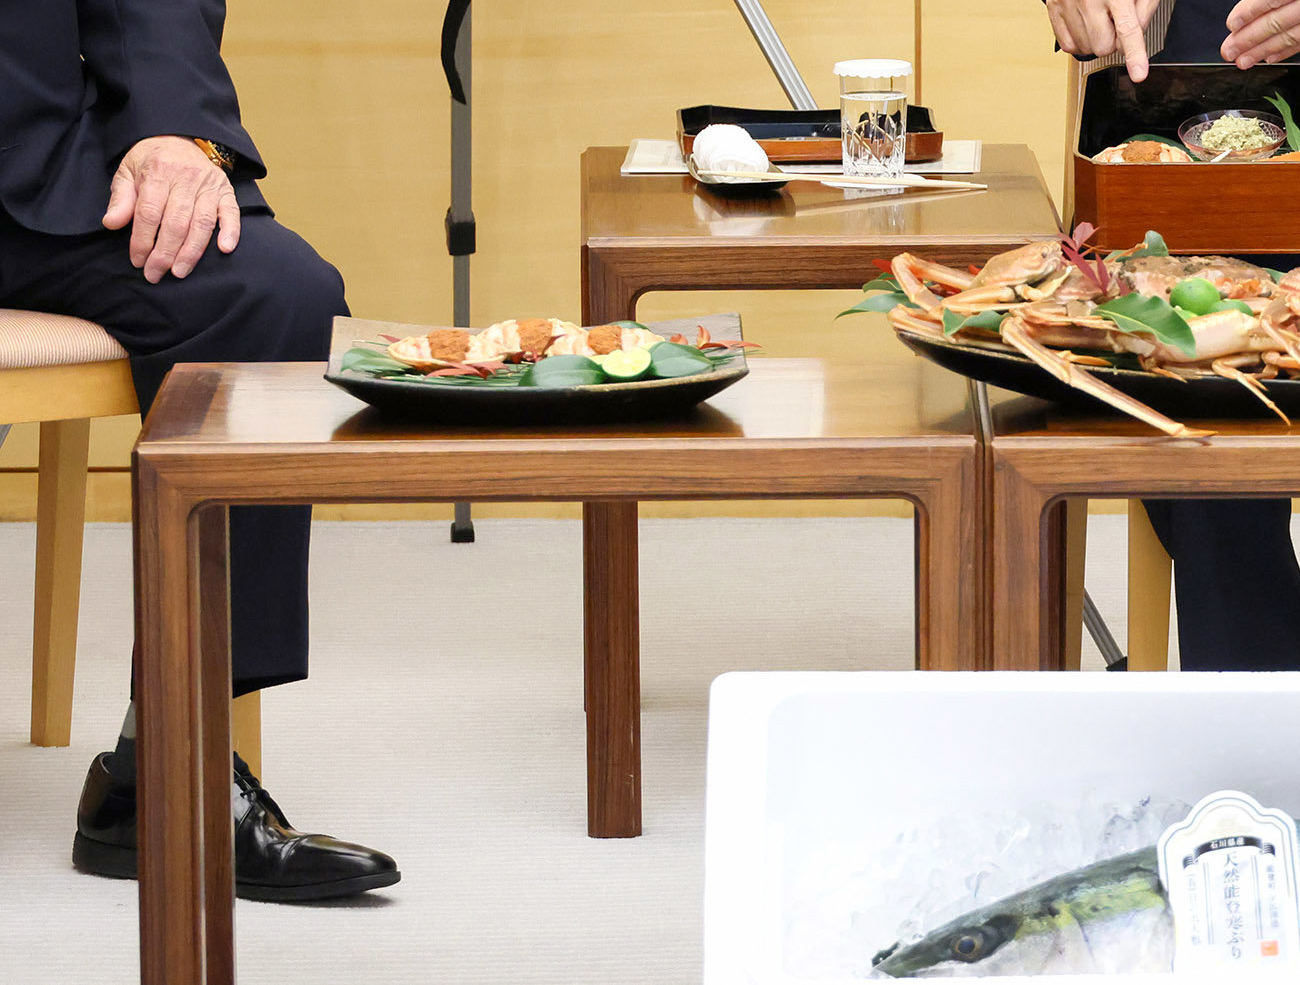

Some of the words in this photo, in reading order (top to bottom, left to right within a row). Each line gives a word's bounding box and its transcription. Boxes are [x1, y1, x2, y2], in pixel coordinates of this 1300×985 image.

[1223, 851, 1245, 959] 天然能登寒ぶり
